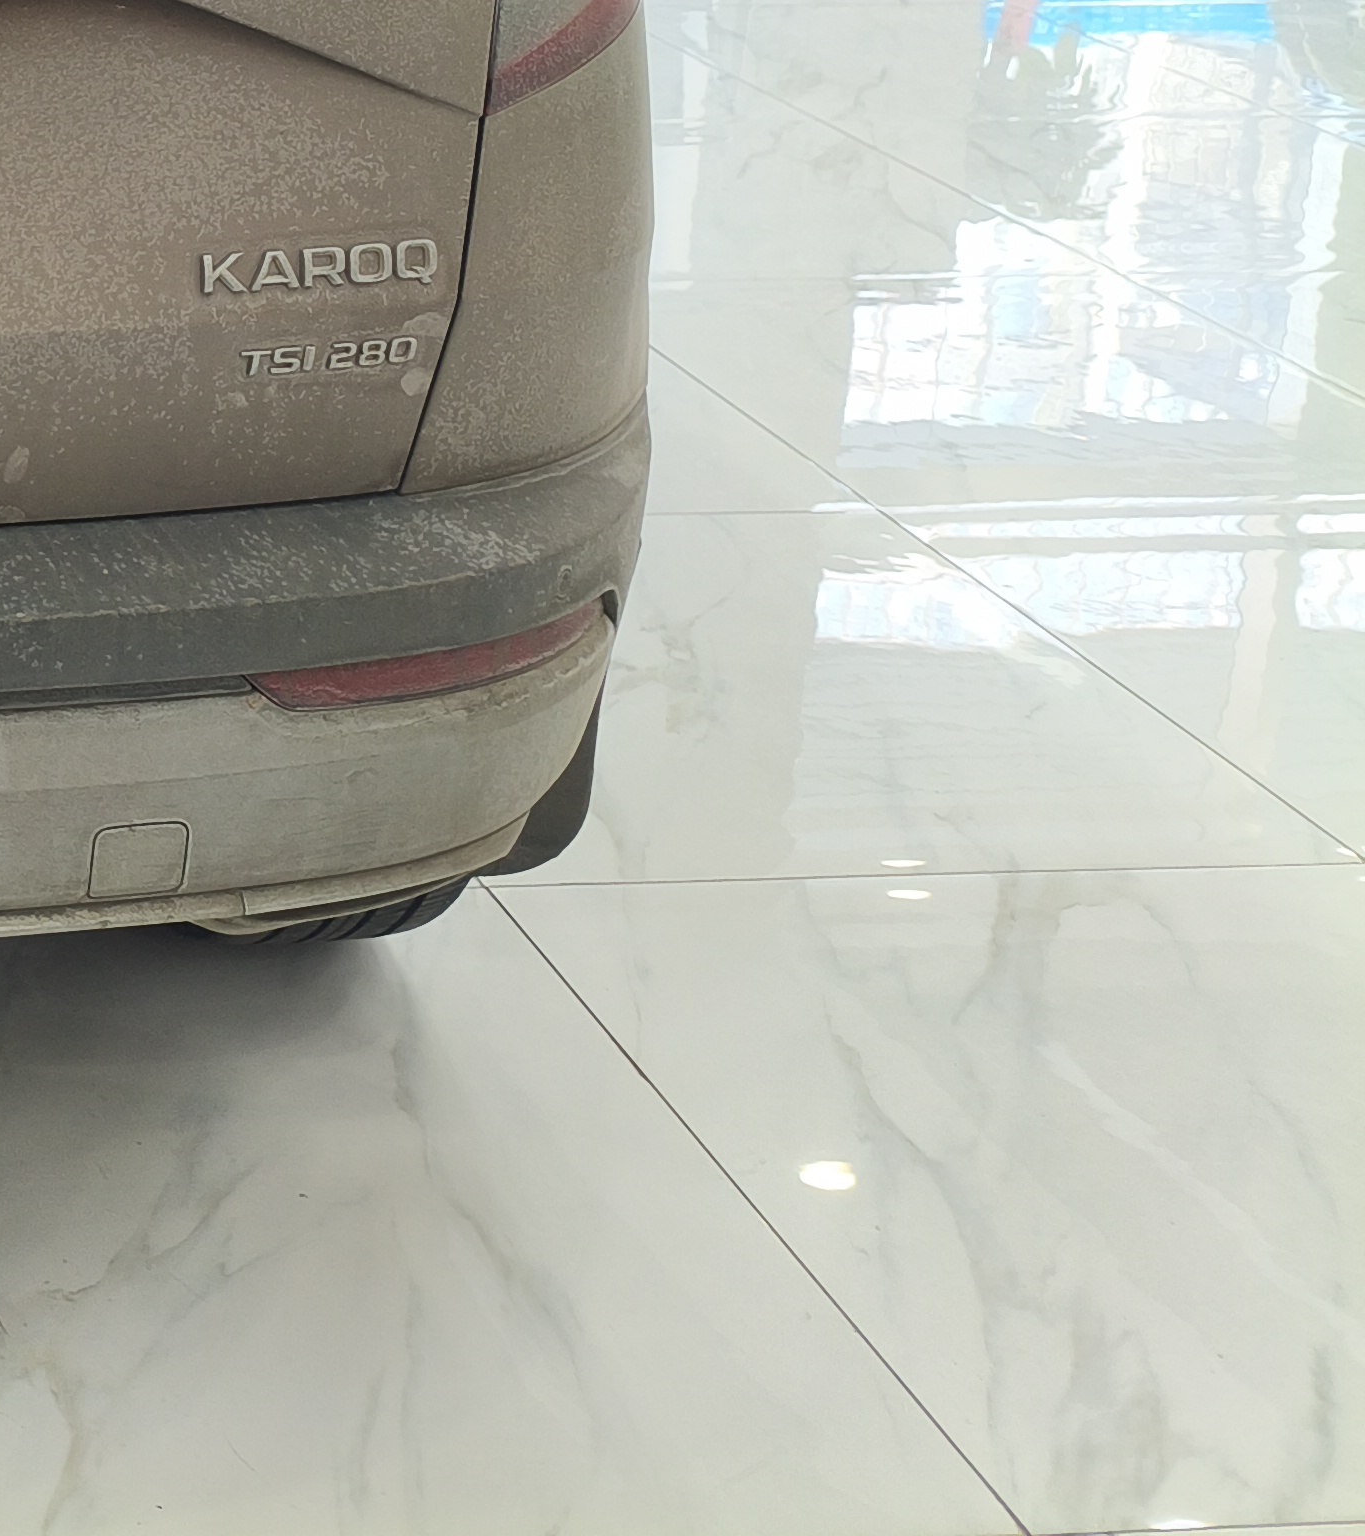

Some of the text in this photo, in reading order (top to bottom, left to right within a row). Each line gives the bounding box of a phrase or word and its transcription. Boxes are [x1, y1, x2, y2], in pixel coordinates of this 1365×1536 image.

[201, 238, 439, 295] KAROQ
[240, 336, 418, 376] TSI 280
